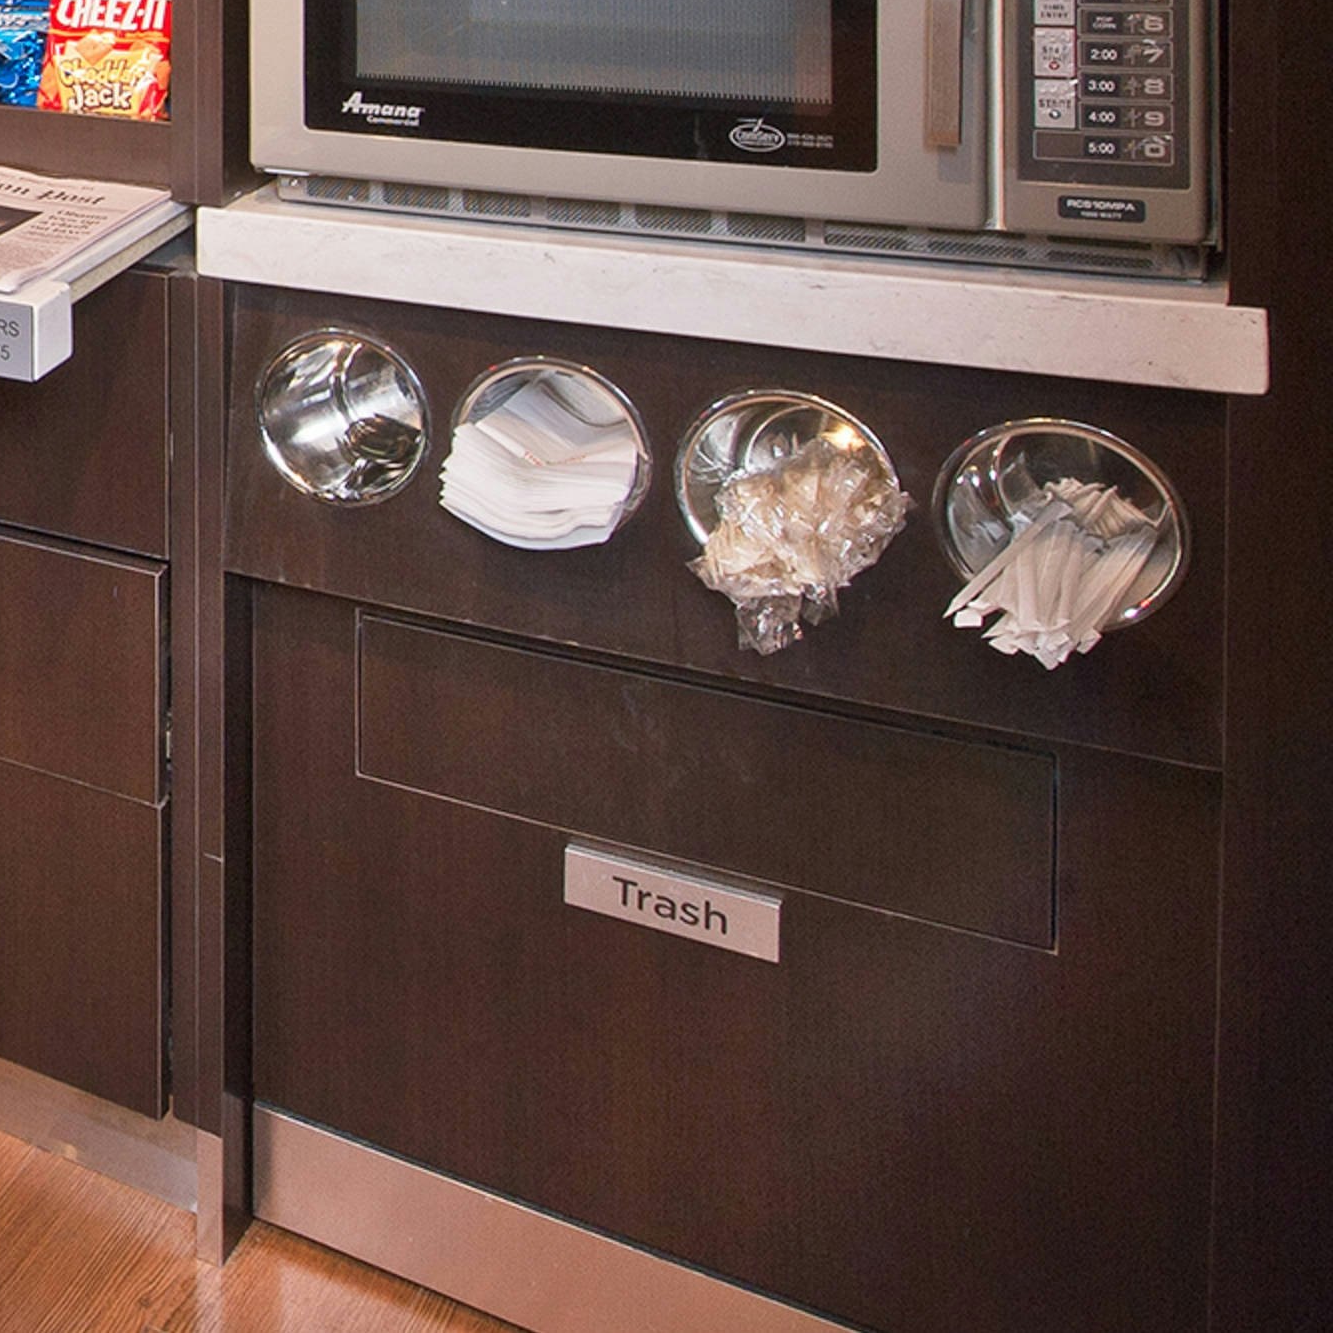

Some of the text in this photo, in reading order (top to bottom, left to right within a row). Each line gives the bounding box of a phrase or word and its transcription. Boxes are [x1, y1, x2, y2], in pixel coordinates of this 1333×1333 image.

[1091, 49, 1117, 60] 2:00
[61, 58, 148, 86] Cheddar
[1089, 80, 1115, 91] 3:00
[1144, 79, 1164, 94] 8
[68, 83, 132, 114] Jack
[341, 91, 425, 117] Amana
[1089, 112, 1115, 122] 4:00
[1144, 111, 1164, 126] 9
[1089, 143, 1115, 153] 5:00
[36, 188, 106, 207] Post
[612, 875, 728, 934] Trash
